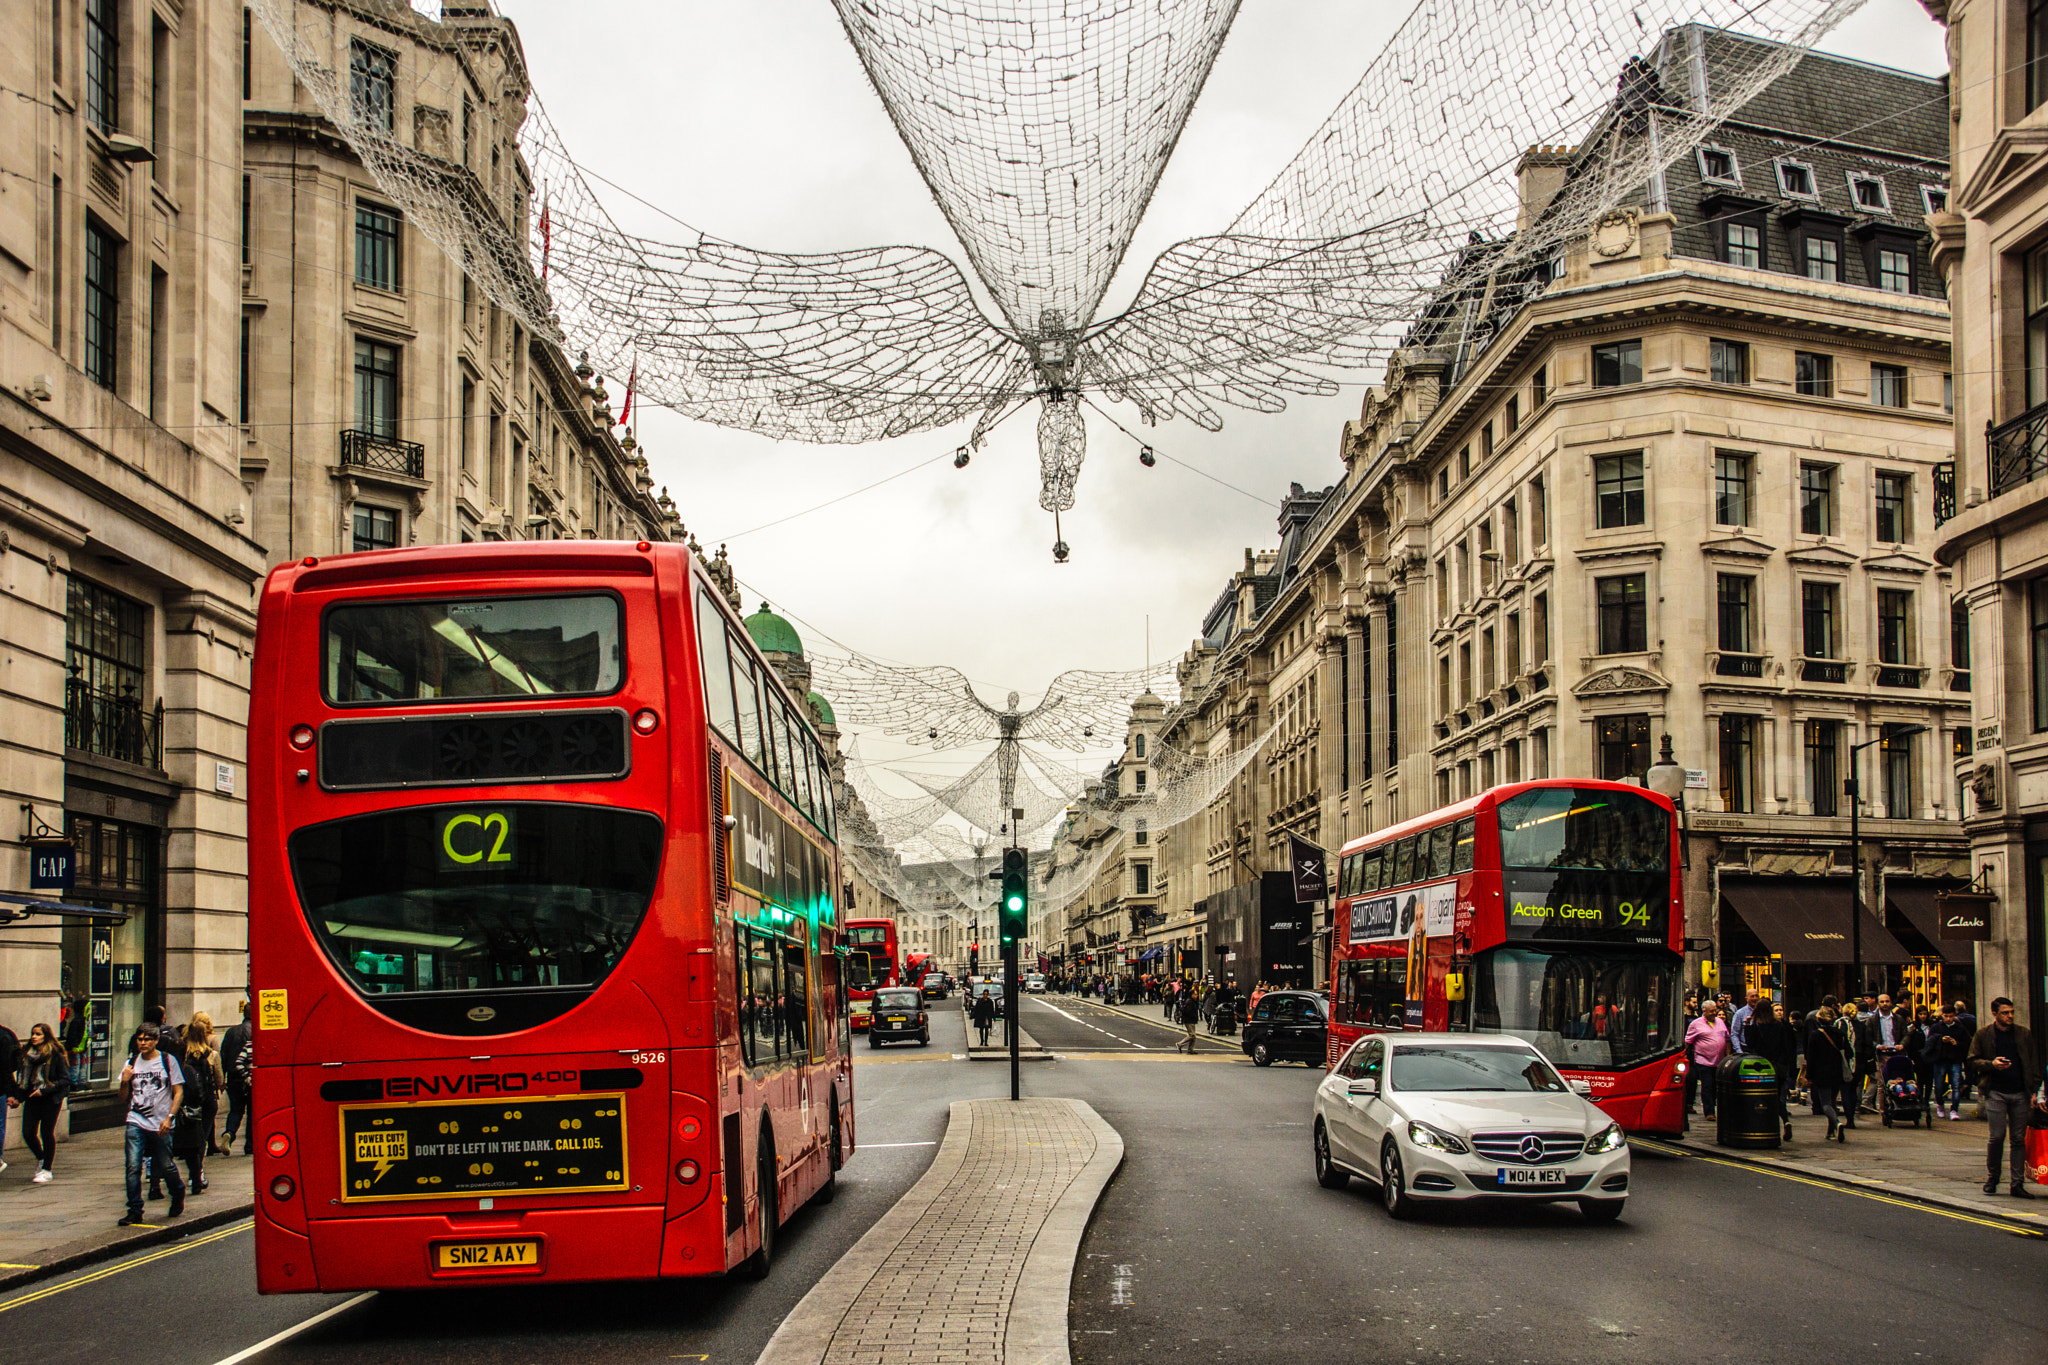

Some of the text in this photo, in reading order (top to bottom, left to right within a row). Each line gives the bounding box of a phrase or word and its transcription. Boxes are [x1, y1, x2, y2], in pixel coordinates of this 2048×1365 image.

[1977, 725, 1998, 738] REGENT
[1976, 737, 1995, 751] STREET
[443, 812, 512, 864] C2
[39, 857, 67, 877] GAP
[1352, 900, 1393, 928] GIANT SAVINGS
[1513, 901, 1651, 926] Acton Green 94
[1947, 915, 1985, 927] Clarks
[119, 969, 135, 981] GAP
[632, 1052, 666, 1064] 9526
[386, 1070, 577, 1097] ENVIRO 400
[1591, 1080, 1615, 1088] GROUP
[358, 1132, 405, 1144] POWER CUT?
[359, 1143, 405, 1158] CALL 105
[415, 1137, 604, 1156] DON'T BE LEFT IN THE DARK. CALL 105.
[1509, 1170, 1561, 1182] WO14 WEX
[450, 1245, 526, 1264] SN12 AAY
